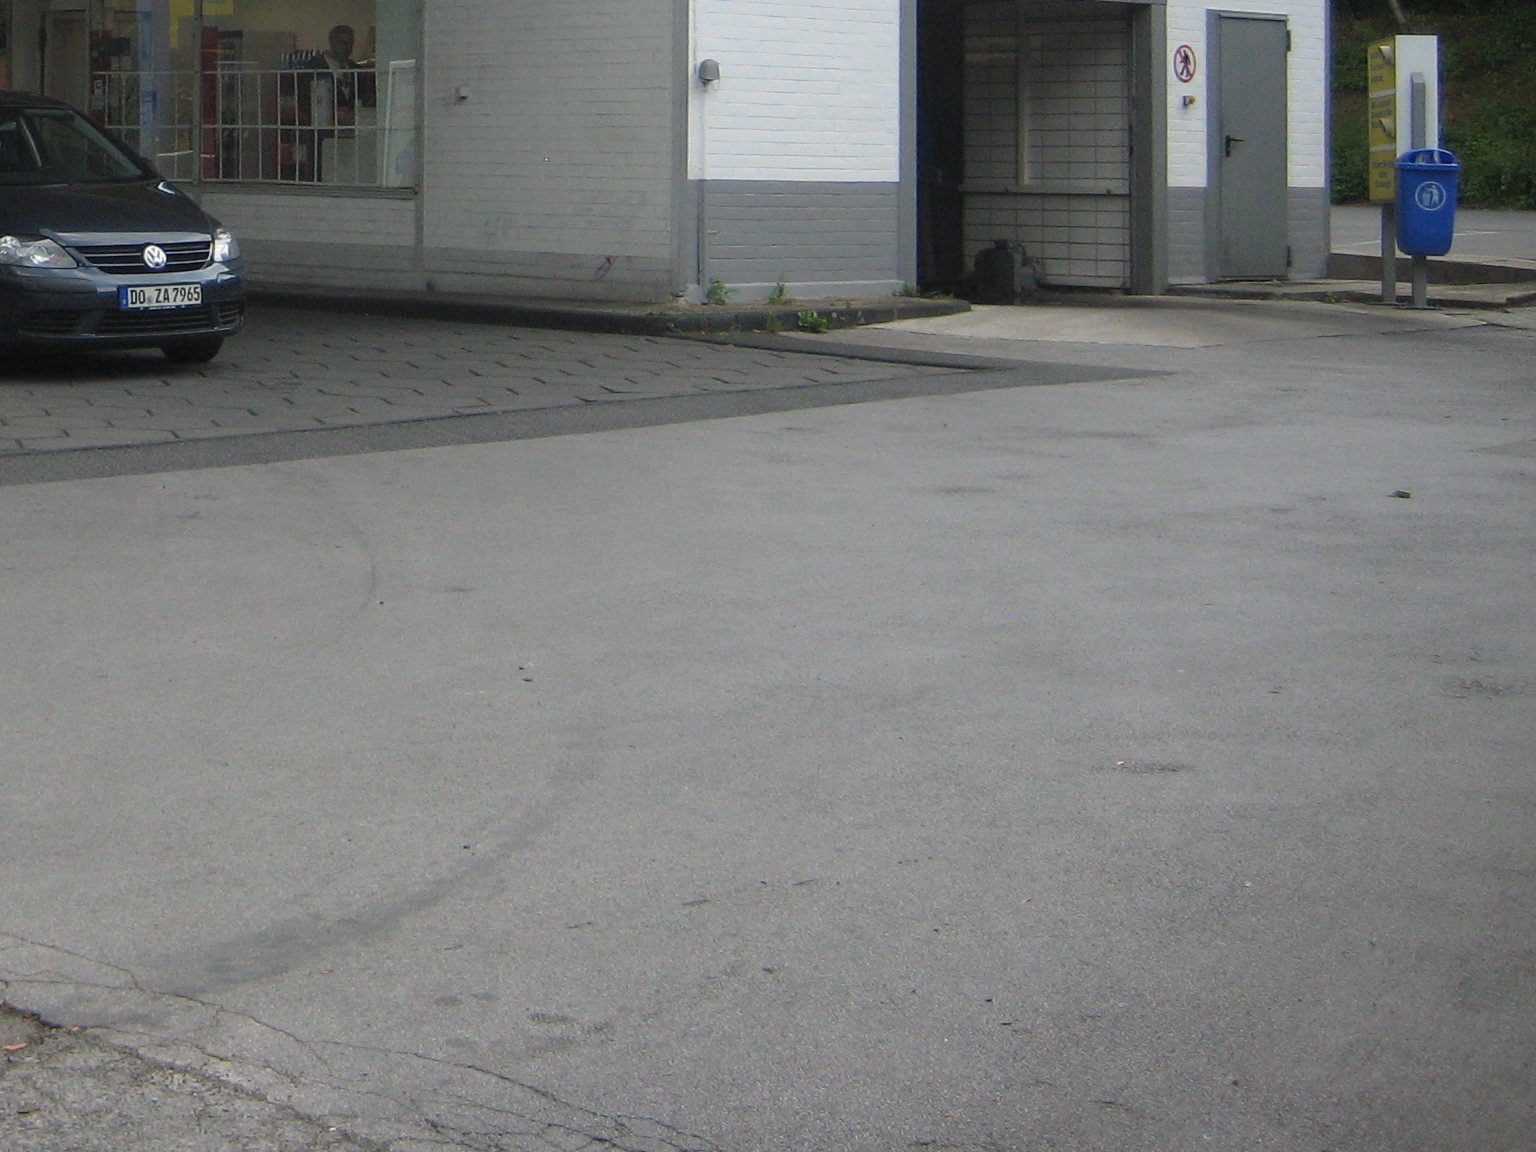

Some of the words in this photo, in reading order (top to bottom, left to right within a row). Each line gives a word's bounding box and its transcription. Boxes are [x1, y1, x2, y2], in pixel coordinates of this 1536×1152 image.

[129, 289, 146, 305] DO
[154, 288, 170, 304] ZA
[172, 286, 201, 303] 7965
